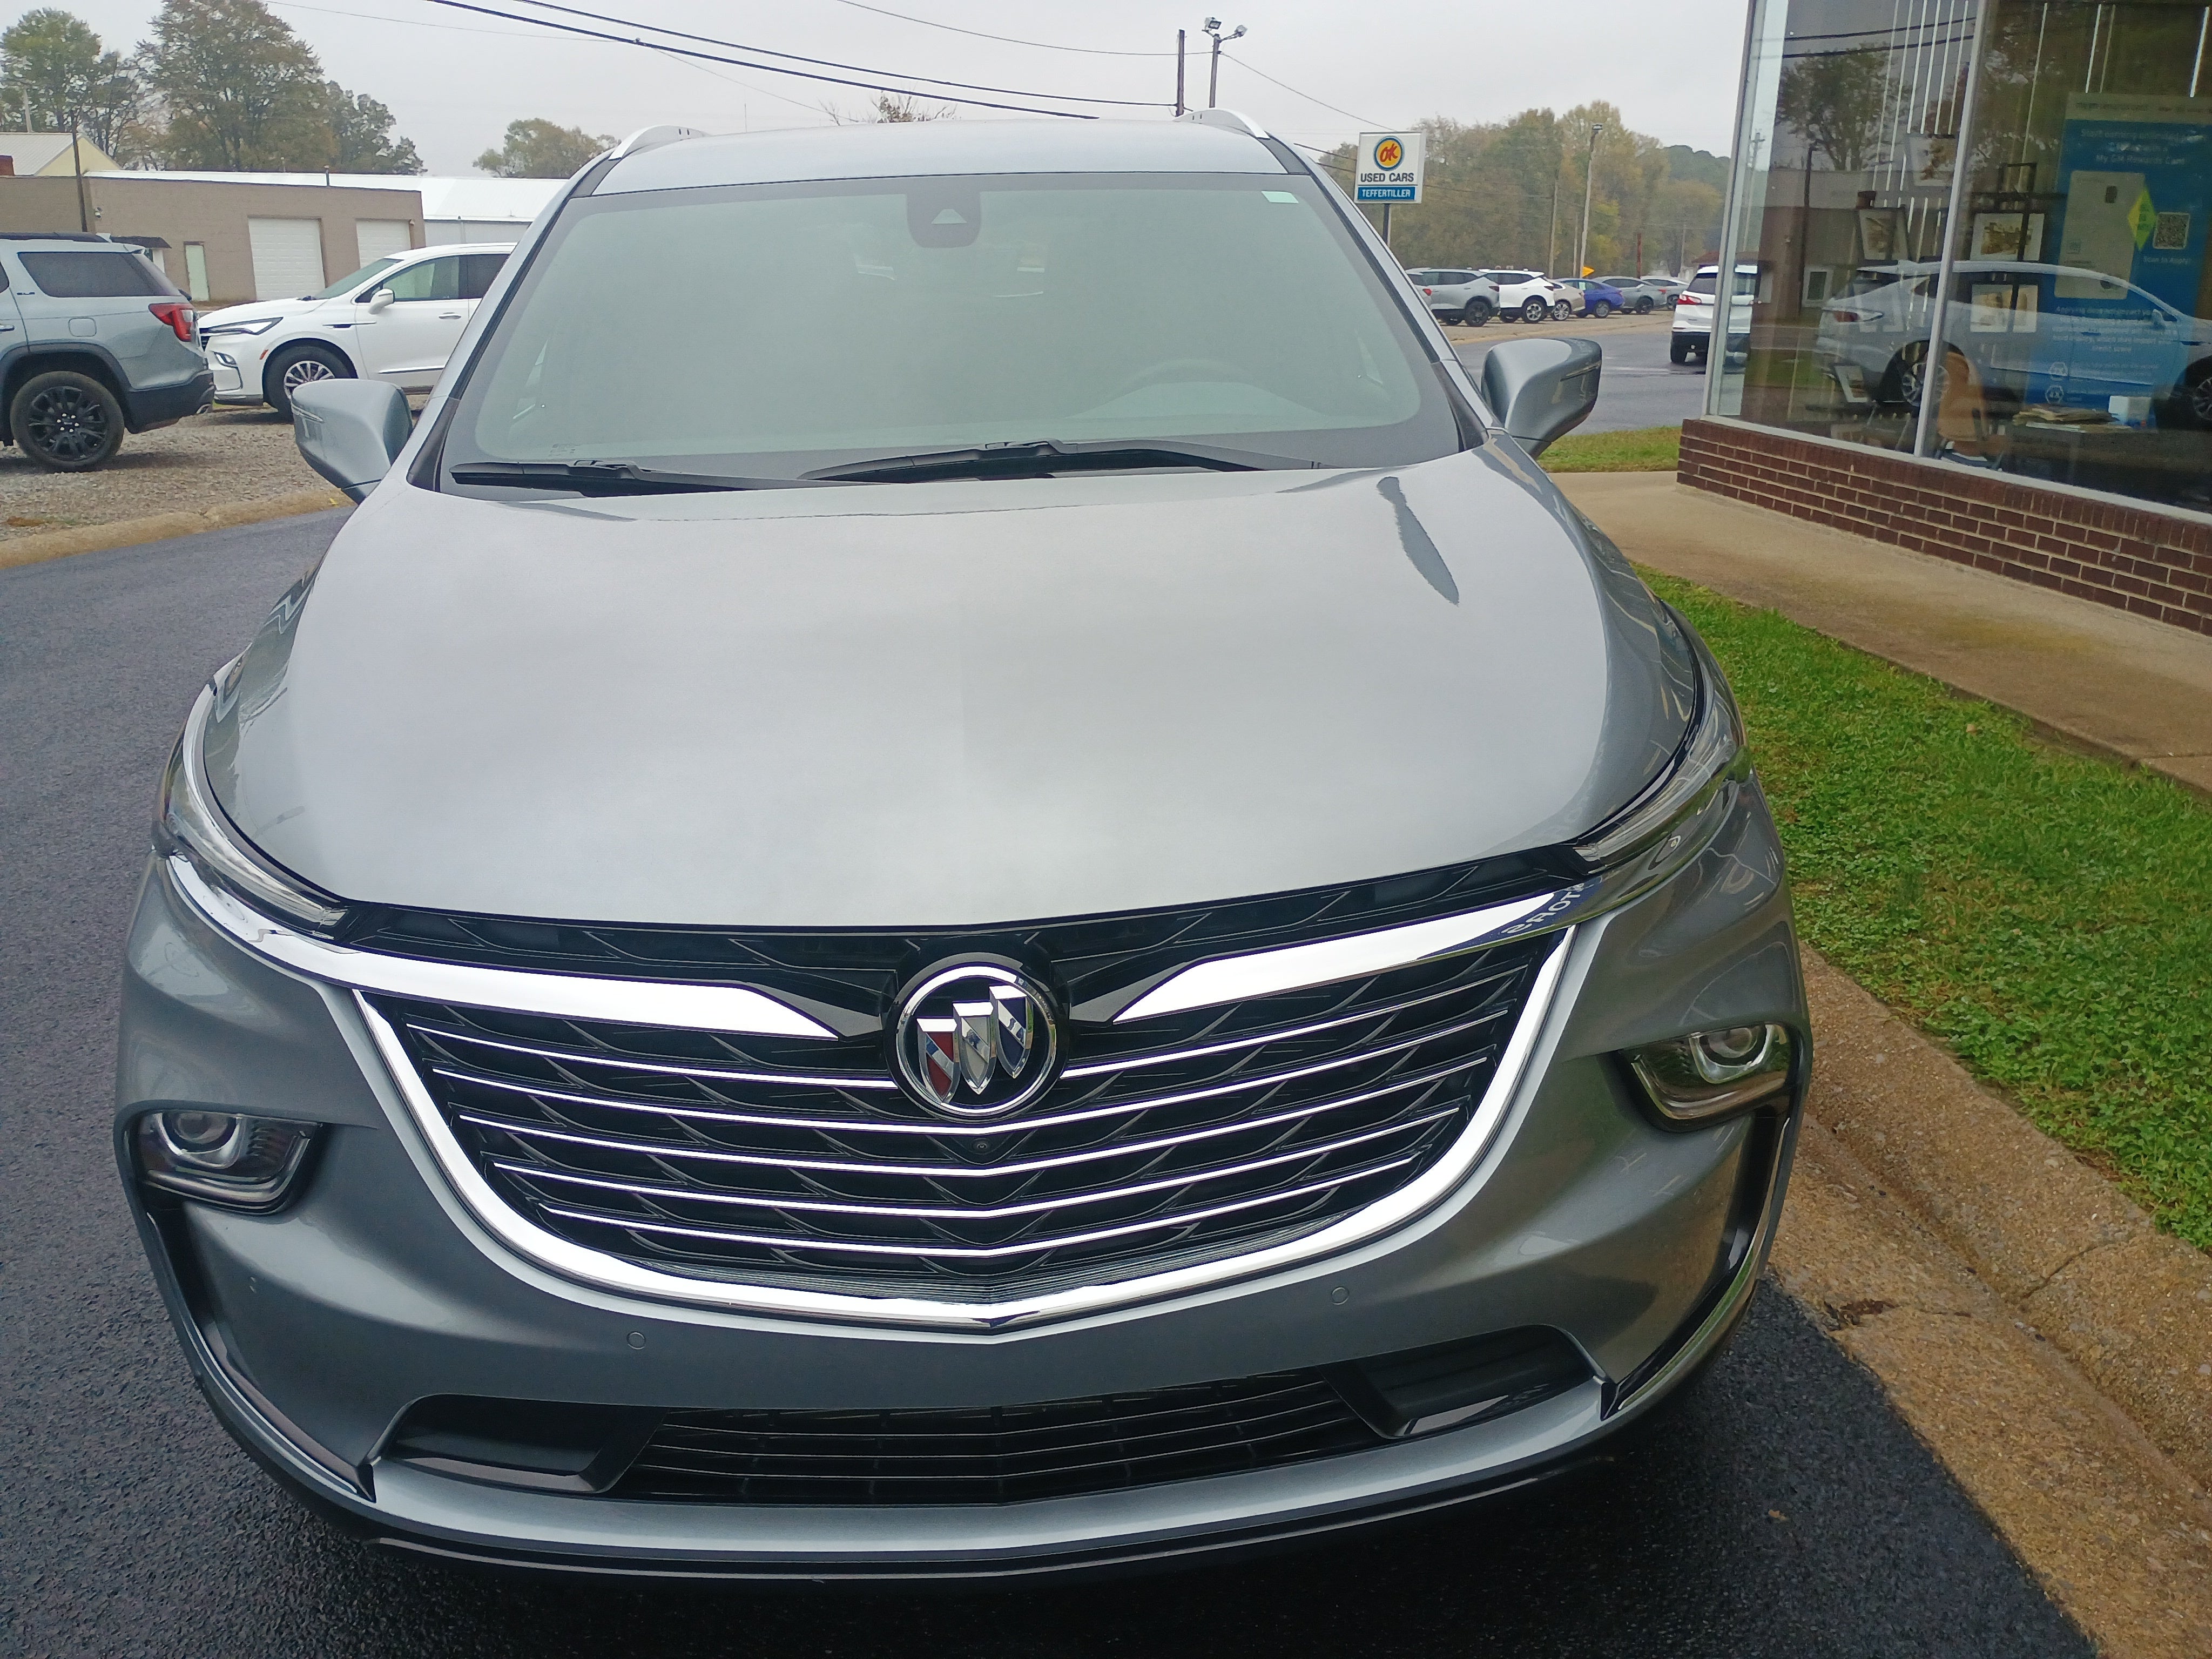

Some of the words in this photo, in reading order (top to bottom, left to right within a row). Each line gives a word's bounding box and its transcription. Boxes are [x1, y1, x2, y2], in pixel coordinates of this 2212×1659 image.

[1380, 143, 1398, 162] OK
[1360, 173, 1386, 183] USED
[1388, 172, 1414, 183] CARS
[1362, 189, 1411, 198] TEFFERTILLER
